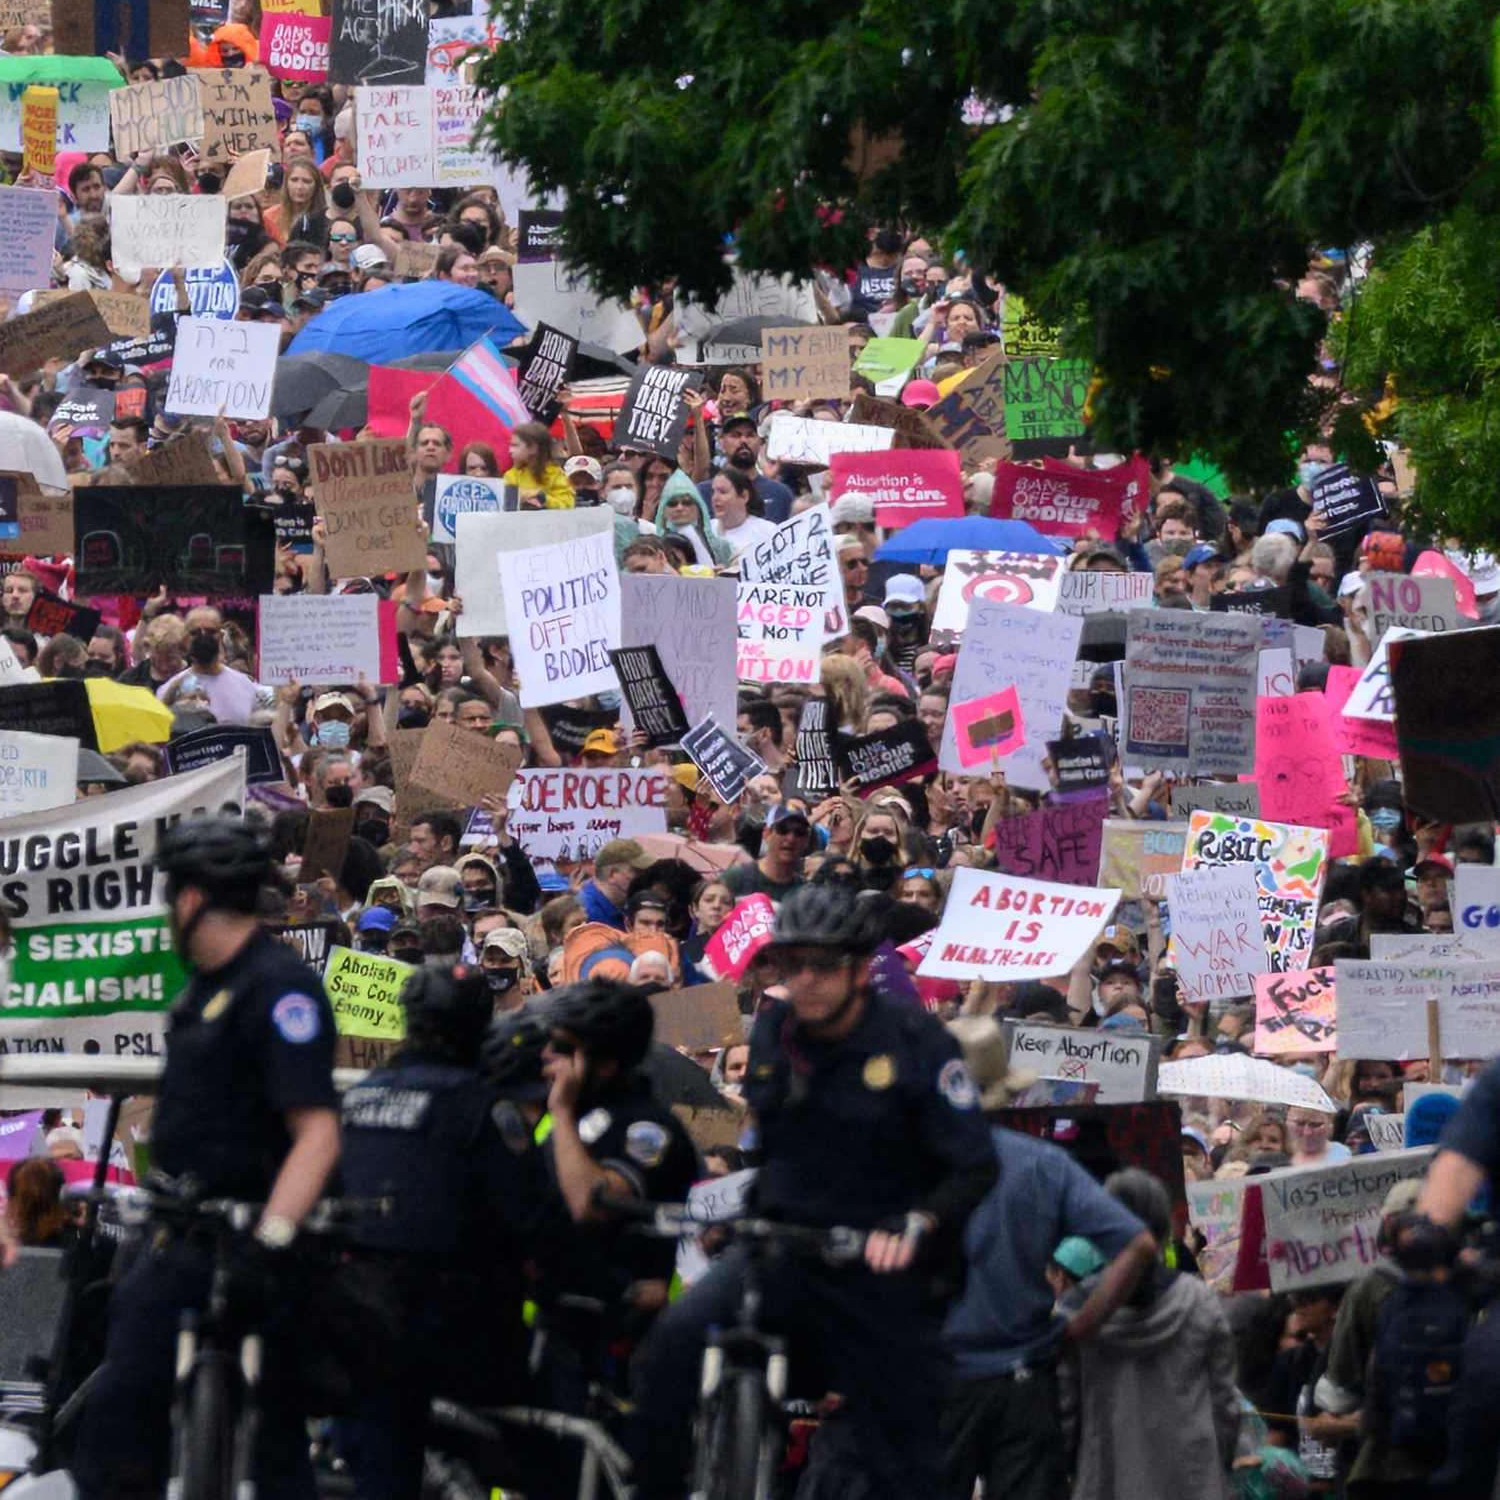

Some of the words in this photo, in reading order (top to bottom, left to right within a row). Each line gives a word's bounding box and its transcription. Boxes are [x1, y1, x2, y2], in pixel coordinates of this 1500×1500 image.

[207, 110, 258, 129] WITH
[360, 113, 420, 131] TAKE
[222, 130, 257, 152] HER
[767, 335, 803, 356] MY
[209, 357, 235, 370] FOR
[646, 367, 689, 390] HOW
[767, 367, 805, 389] MY
[169, 373, 265, 411] ABORTION
[635, 386, 687, 413] DARE
[627, 410, 675, 443] THEY.
[846, 473, 908, 487] Abortion
[910, 473, 923, 487] is
[1014, 477, 1071, 497] BANS
[903, 486, 947, 503] Care.
[1013, 490, 1053, 510] OFF
[1056, 493, 1101, 512] OUR
[1013, 505, 1090, 525] BODIES
[521, 570, 608, 617] POLITICS
[751, 587, 790, 605] ARE
[790, 590, 825, 608] NOT
[1371, 580, 1420, 613] NO
[530, 619, 574, 653] OFF
[543, 639, 610, 683] BODIES
[1015, 833, 1086, 867] SAFE
[1197, 830, 1273, 862] PUBLIC
[970, 884, 1107, 918] ABORTION
[1004, 918, 1042, 941] IS
[1175, 921, 1258, 957] WAR
[28, 929, 172, 961] SEXIST!
[940, 943, 1058, 967] HEALTHCARE
[339, 959, 400, 982] Abolish
[1209, 956, 1233, 970] ON
[1176, 971, 1257, 1000] WOMEN
[335, 997, 384, 1026] Enemy
[1013, 1033, 1048, 1054] Keep
[1056, 1038, 1139, 1065] Abortion
